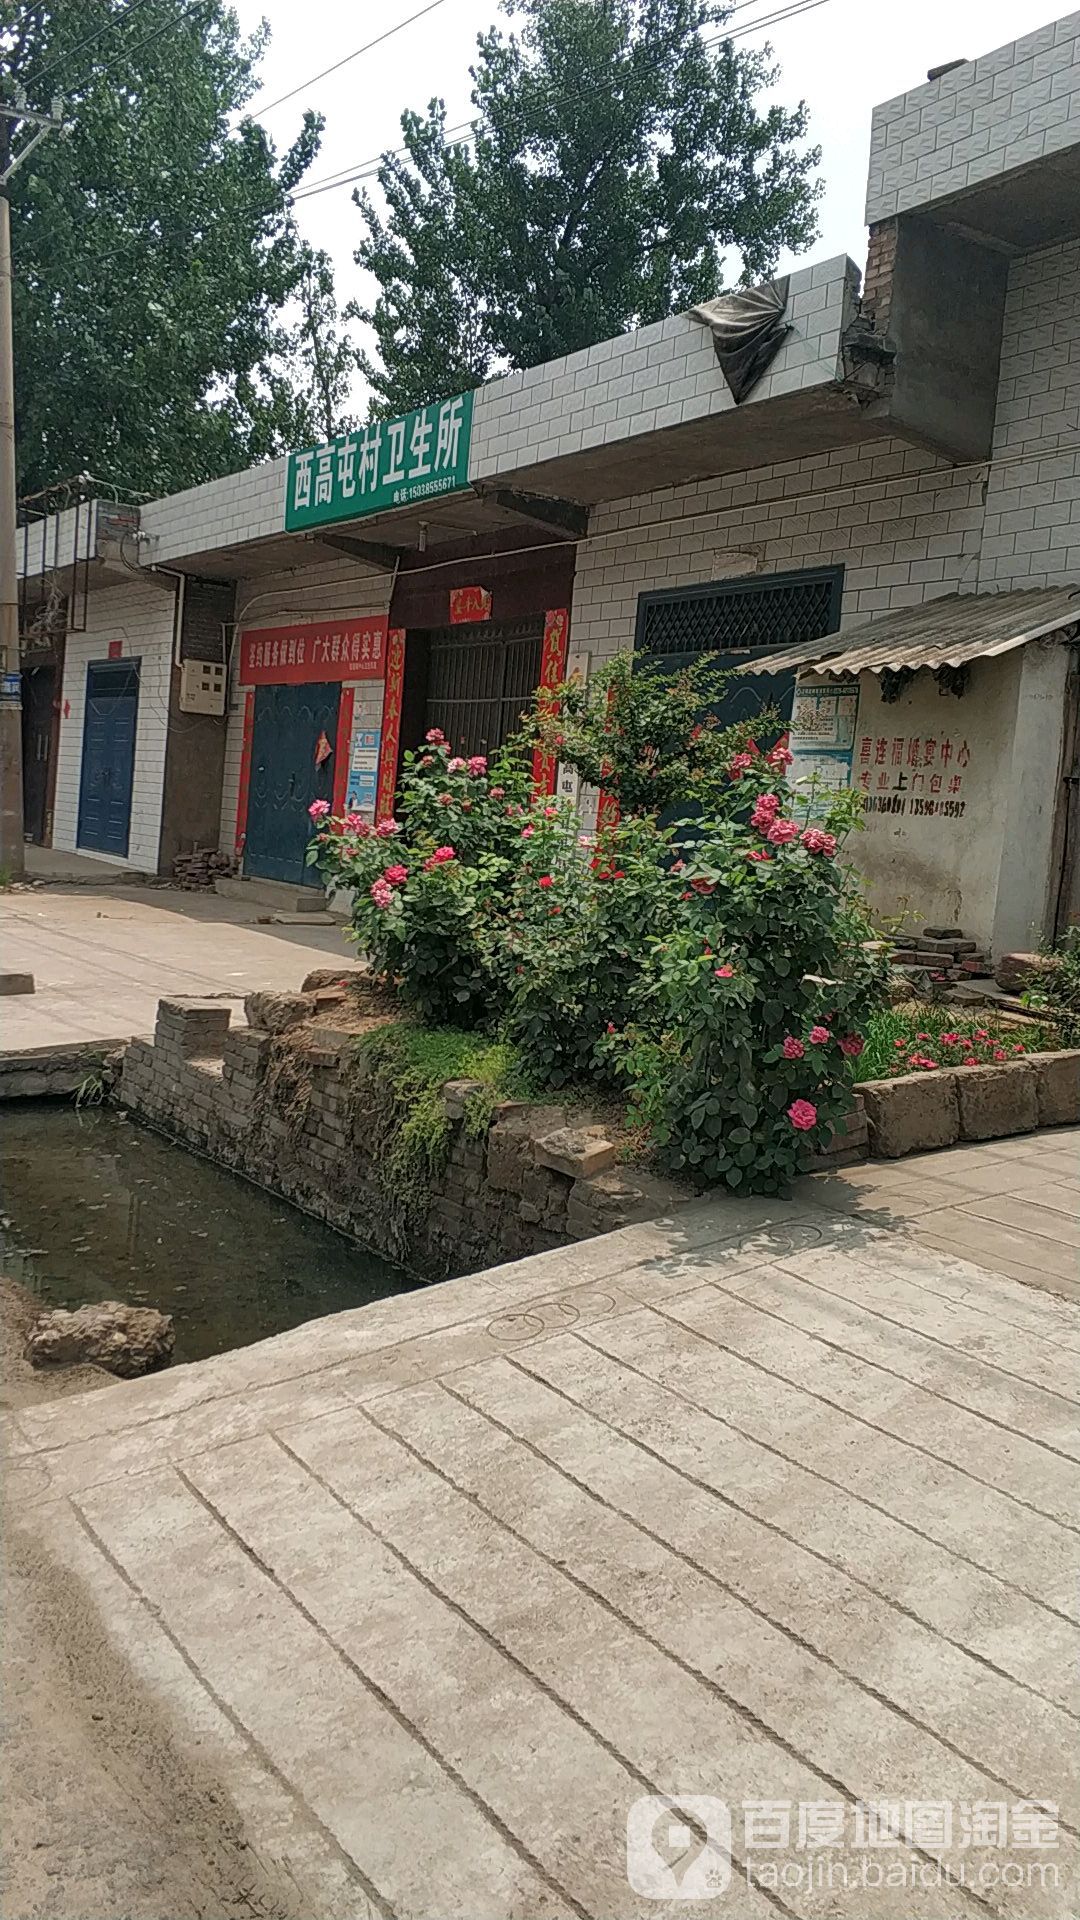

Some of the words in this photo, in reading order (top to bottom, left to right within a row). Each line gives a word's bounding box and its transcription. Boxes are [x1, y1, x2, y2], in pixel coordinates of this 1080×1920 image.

[294, 396, 464, 511] 西高屯村卫生所
[311, 630, 384, 664] 广大群众得实惠
[860, 770, 963, 794] 专业上门包桌
